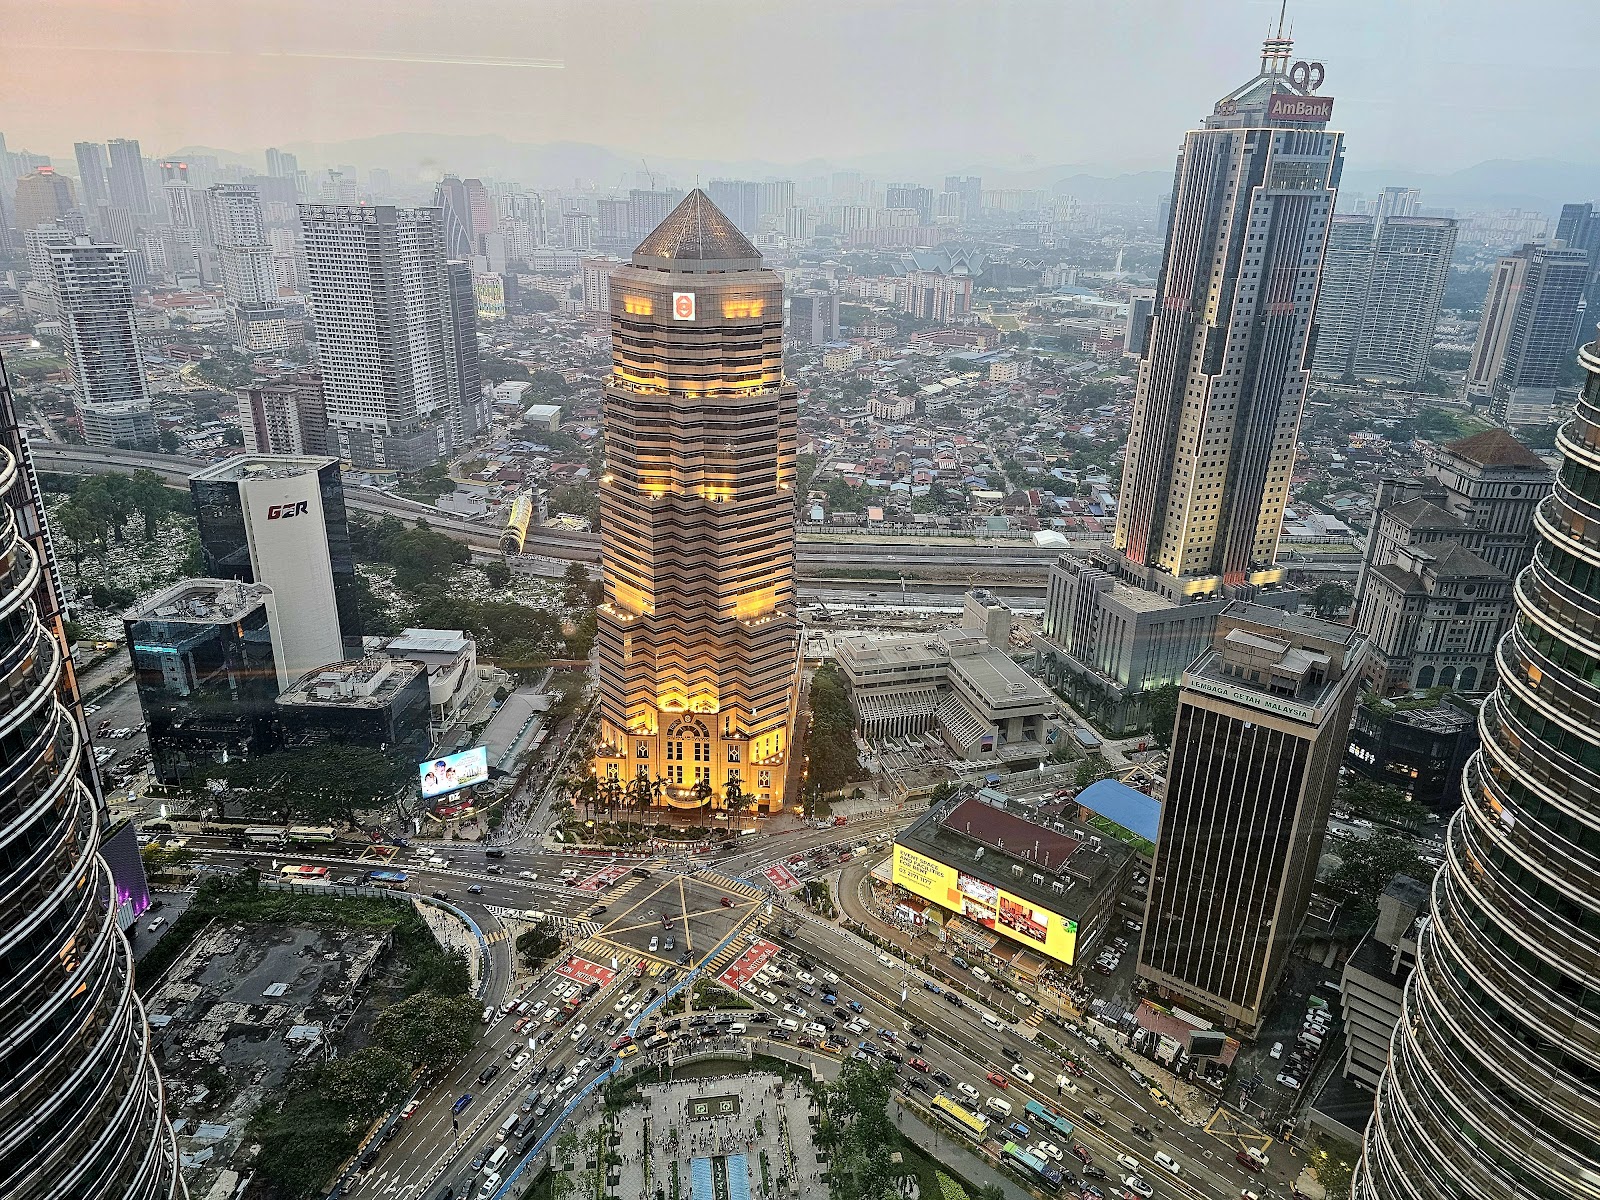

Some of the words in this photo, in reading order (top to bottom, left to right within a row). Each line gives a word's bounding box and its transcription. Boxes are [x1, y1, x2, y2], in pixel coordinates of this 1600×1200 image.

[1271, 101, 1331, 116] AmBank
[1191, 680, 1228, 696] LEMBAGA
[1233, 692, 1261, 705] GETAH
[1264, 701, 1308, 718] MALAYSIA
[899, 850, 920, 862] EVENT
[920, 858, 940, 871] SPACE
[899, 855, 913, 864] AND
[913, 860, 945, 878] FACILITIES
[899, 859, 911, 868] FOR
[912, 864, 928, 876] RENT
